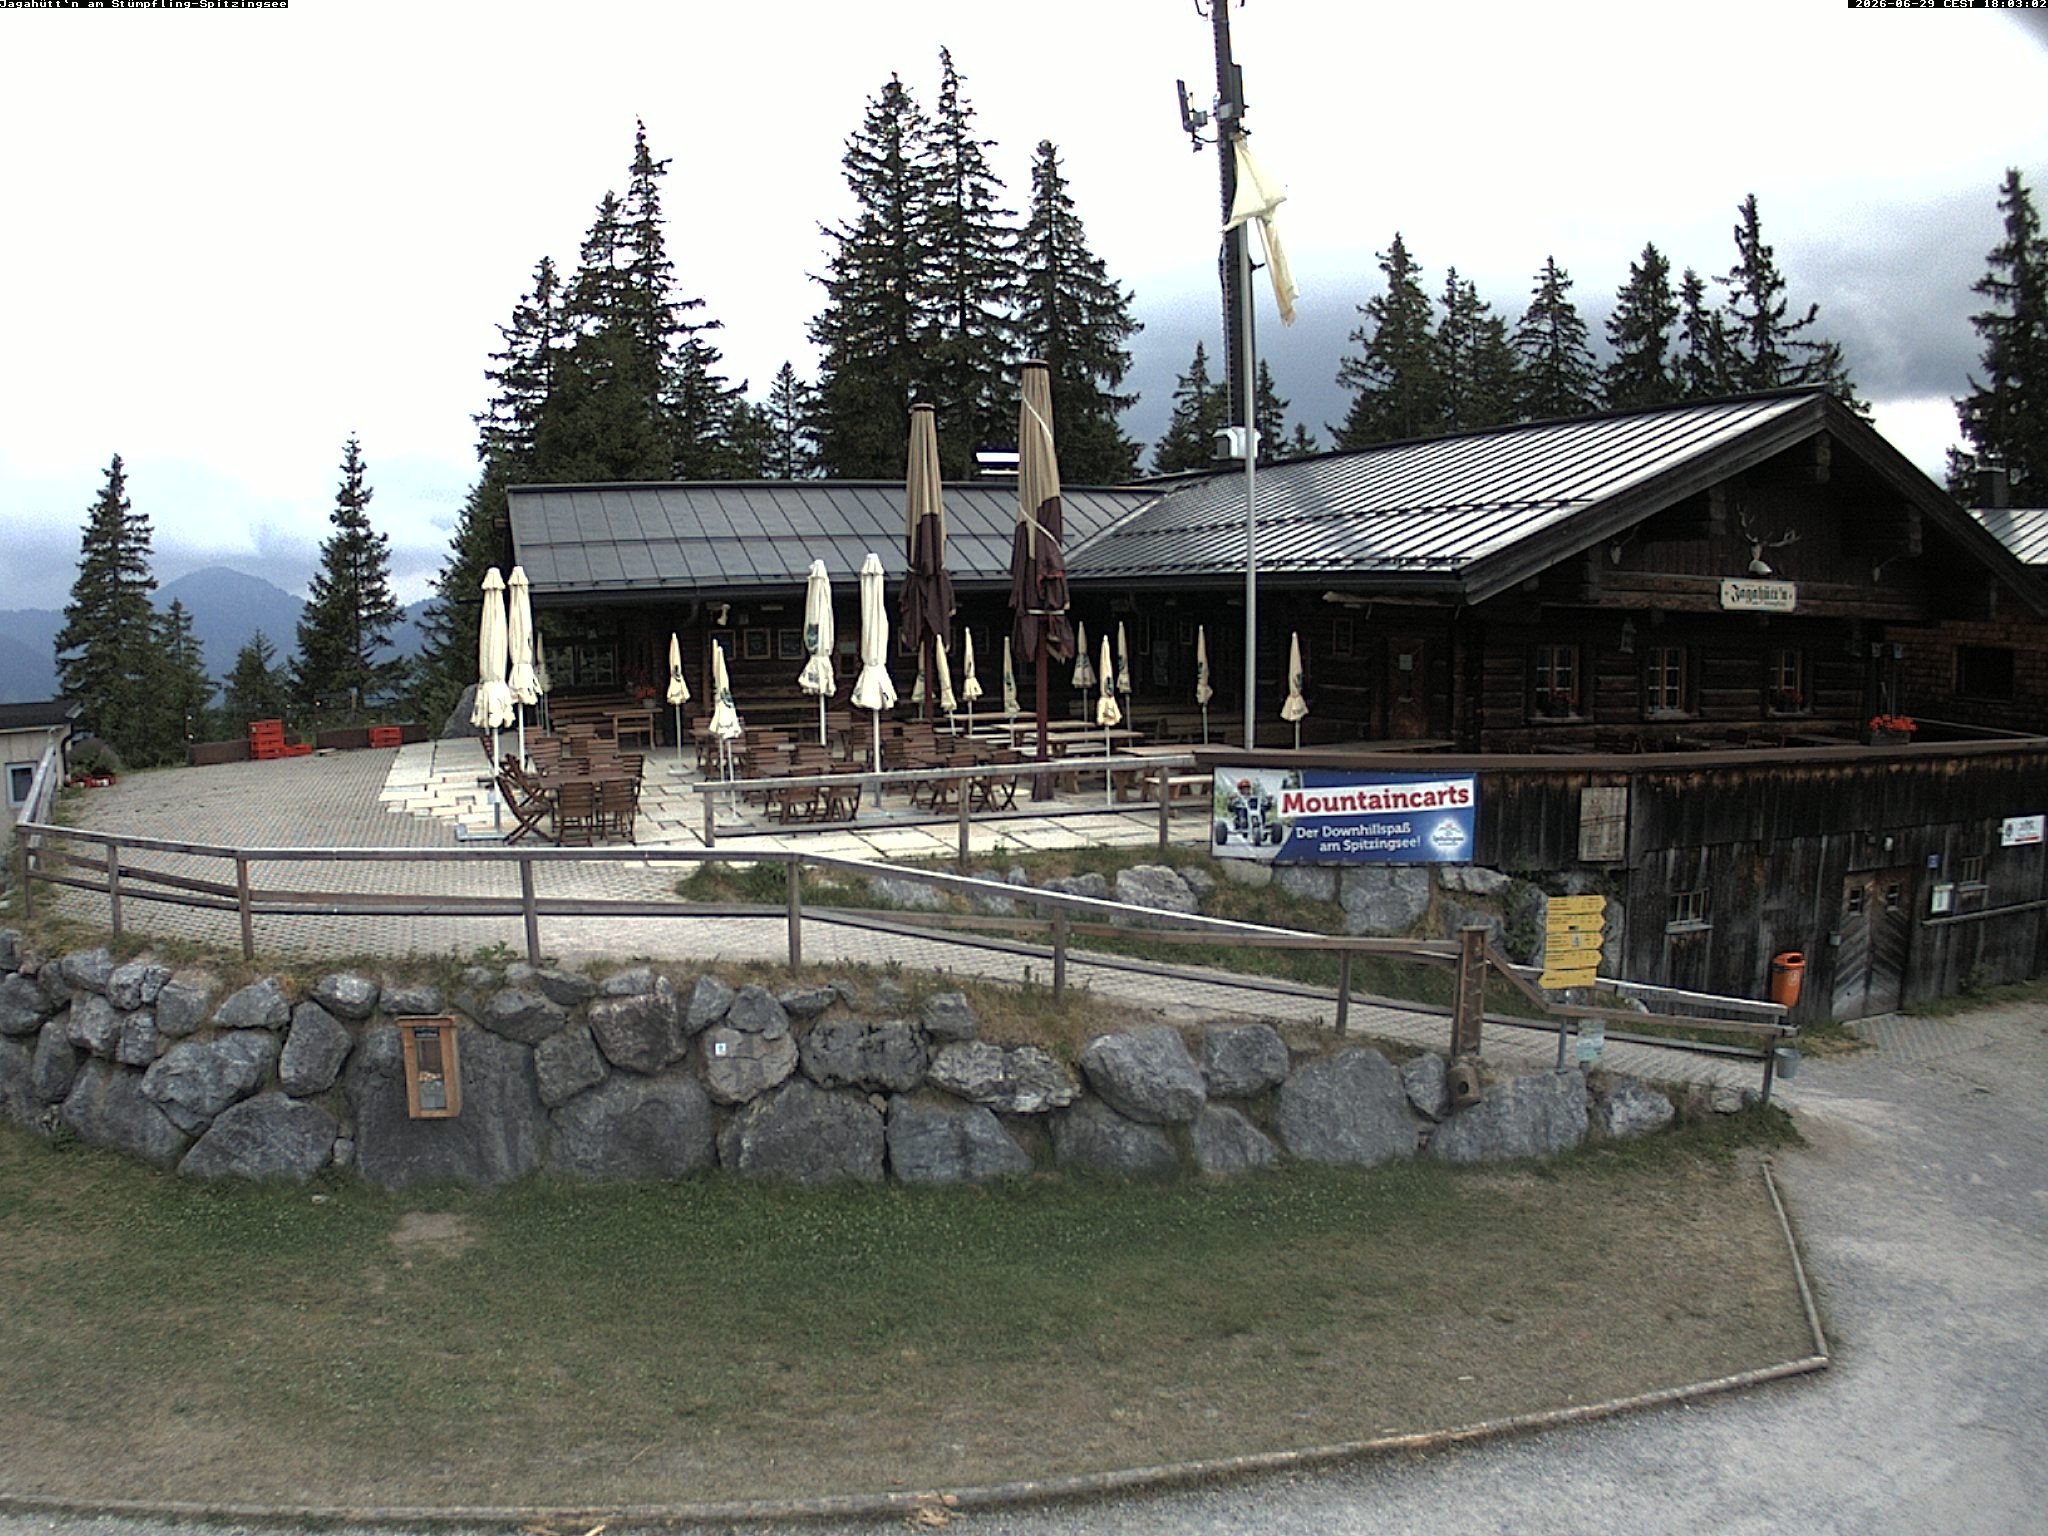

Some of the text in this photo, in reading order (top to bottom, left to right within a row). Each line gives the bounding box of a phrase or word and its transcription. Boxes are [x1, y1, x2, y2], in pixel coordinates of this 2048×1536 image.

[1282, 786, 1469, 813] Mountaincarts
[1296, 822, 1411, 839] Der Downhillspaß
[1319, 842, 1341, 852] am
[1343, 836, 1421, 853] Spitzingsee!
